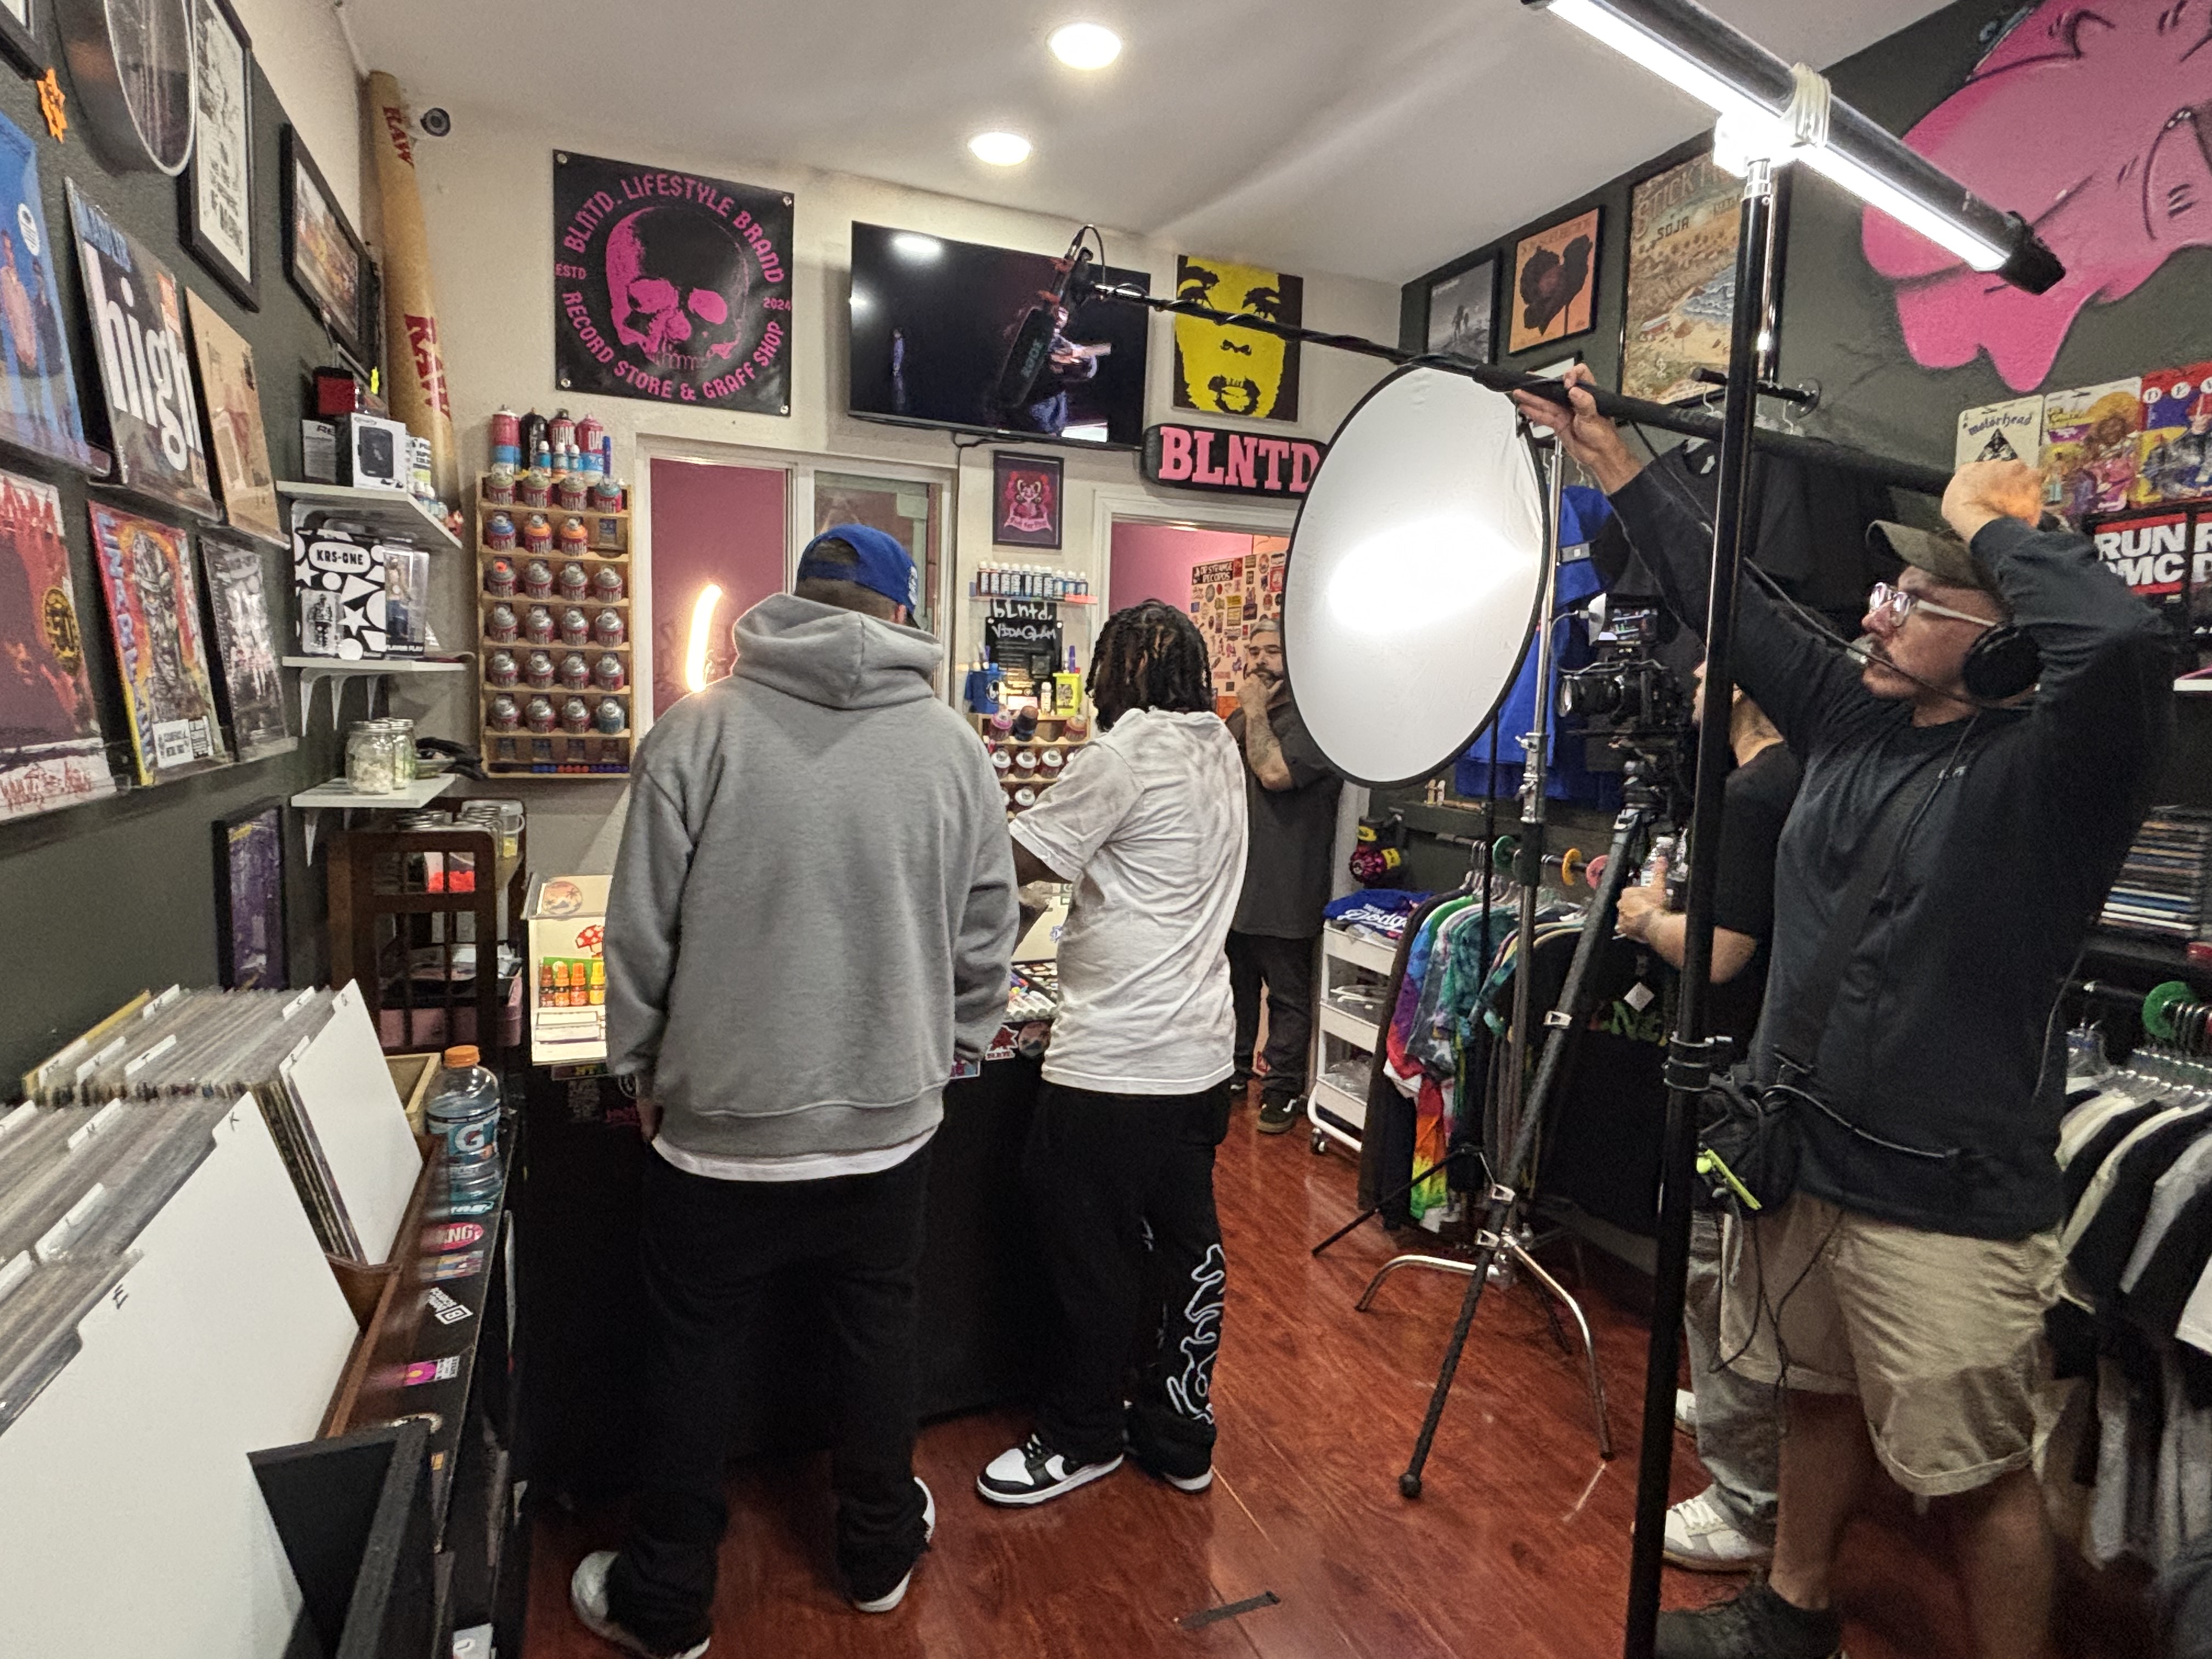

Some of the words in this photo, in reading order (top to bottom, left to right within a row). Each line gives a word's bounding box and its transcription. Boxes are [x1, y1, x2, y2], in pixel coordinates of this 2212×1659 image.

[620, 174, 736, 218] LIFESTYLE
[732, 210, 785, 283] BRAND
[1657, 216, 1690, 241] SOJA
[555, 263, 587, 280] ESTD
[83, 241, 202, 471] high
[562, 291, 614, 364] RECORD
[614, 360, 673, 399] STORE
[680, 383, 697, 401] &
[702, 363, 755, 399] GRAFF
[753, 320, 784, 368] SHOP
[404, 313, 451, 421] RAW
[1159, 426, 1320, 493] BLNTD
[316, 549, 364, 565] KRS-ONE
[2094, 521, 2187, 561] RUN
[2106, 553, 2186, 586] MC
[228, 1111, 240, 1132] K
[455, 1123, 485, 1152] G
[111, 1283, 129, 1311] E
